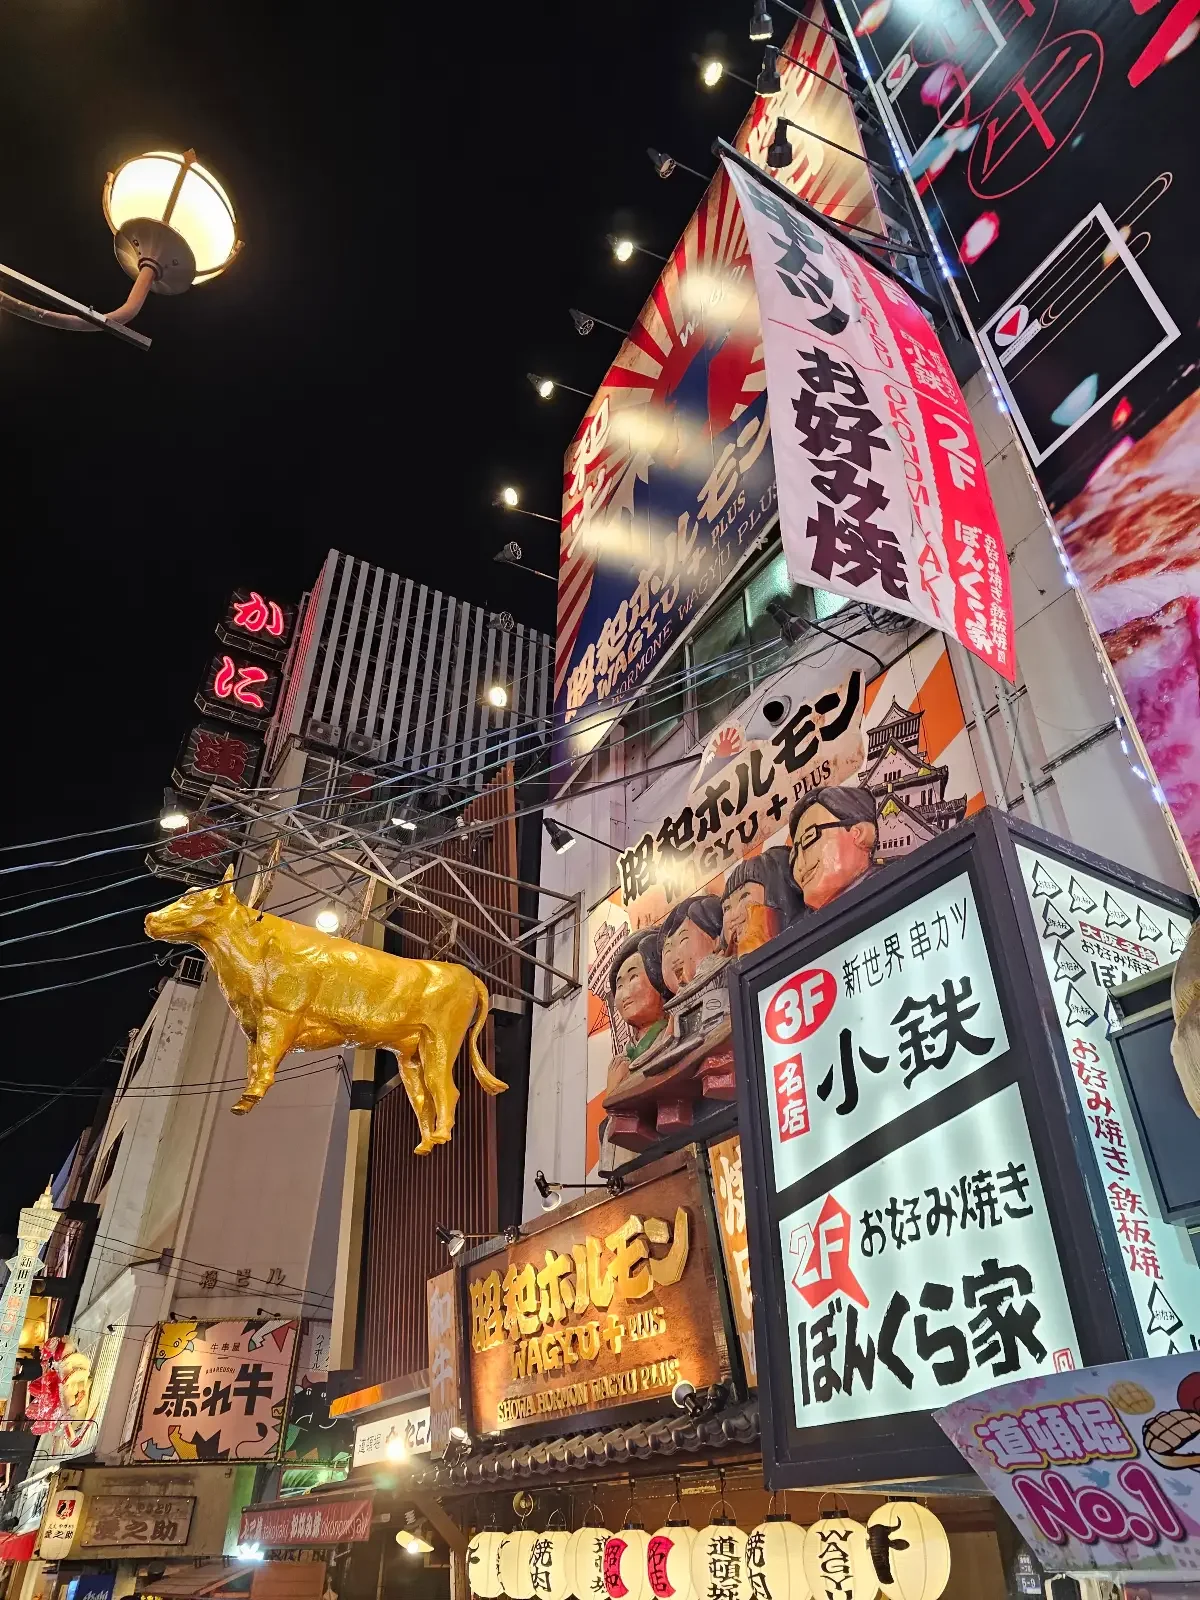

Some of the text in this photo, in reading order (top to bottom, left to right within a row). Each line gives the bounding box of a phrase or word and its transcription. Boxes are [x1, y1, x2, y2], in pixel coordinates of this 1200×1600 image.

[791, 346, 911, 603] お好み焼
[932, 413, 977, 491] 2F
[596, 574, 681, 705] WAGYU
[710, 487, 747, 546] PLUS
[618, 669, 862, 907] 昭和ホルモン
[793, 759, 831, 803] PLUS
[842, 897, 968, 1000] 新世界 串カツ
[775, 972, 827, 1041] 3F
[816, 975, 996, 1116] 小鉄
[778, 1062, 808, 1135] 名店
[859, 1161, 1034, 1258] お好み焼き
[469, 1206, 689, 1353] 昭和ホルモン
[789, 1212, 846, 1288] 2F
[210, 1342, 241, 1353] 牛串屋
[430, 1286, 454, 1405] 和牛
[511, 1320, 600, 1380] WAGYU
[628, 1306, 667, 1342] PLUS
[797, 1257, 1048, 1408] ぼんくら家
[153, 1363, 274, 1418] 暴れ牛
[497, 1393, 537, 1423] SHOWA
[591, 1368, 638, 1400] WAGYU
[639, 1357, 682, 1391] PLUS
[975, 1397, 1135, 1468] 道頓堀
[1011, 1461, 1185, 1545] No.1
[529, 1538, 554, 1593] 焼肉
[707, 1535, 742, 1600] 道頓堀
